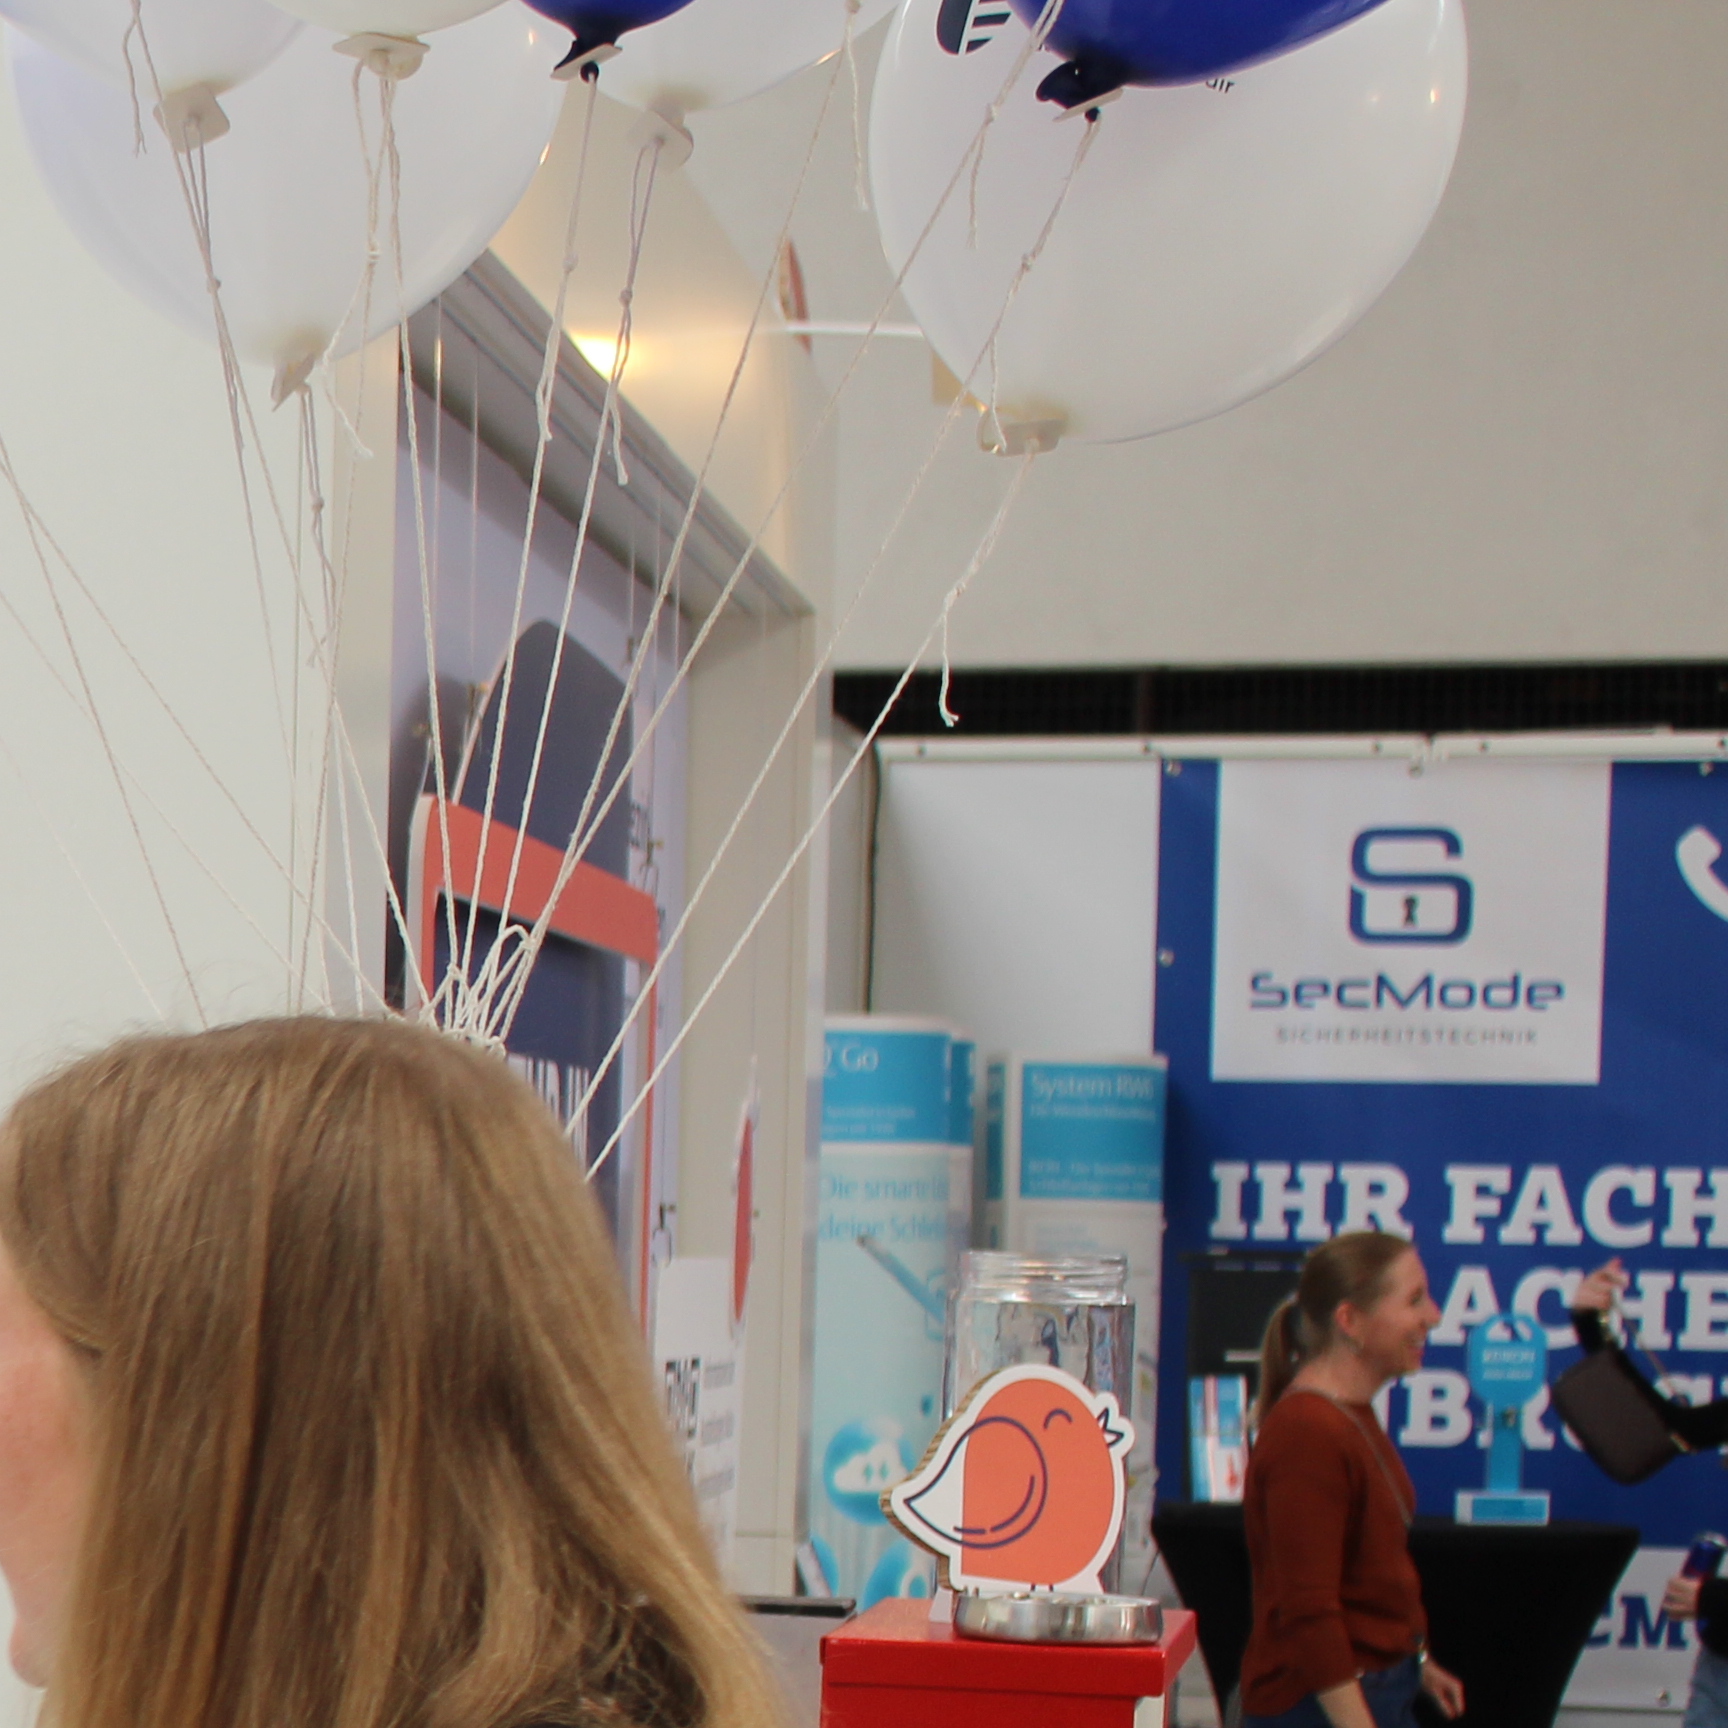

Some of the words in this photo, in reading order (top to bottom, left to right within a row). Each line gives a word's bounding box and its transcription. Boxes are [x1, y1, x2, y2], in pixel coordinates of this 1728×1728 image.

[1250, 970, 1566, 1011] SecMode
[1208, 1161, 1412, 1241] IHR
[1442, 1163, 1728, 1248] FACH
